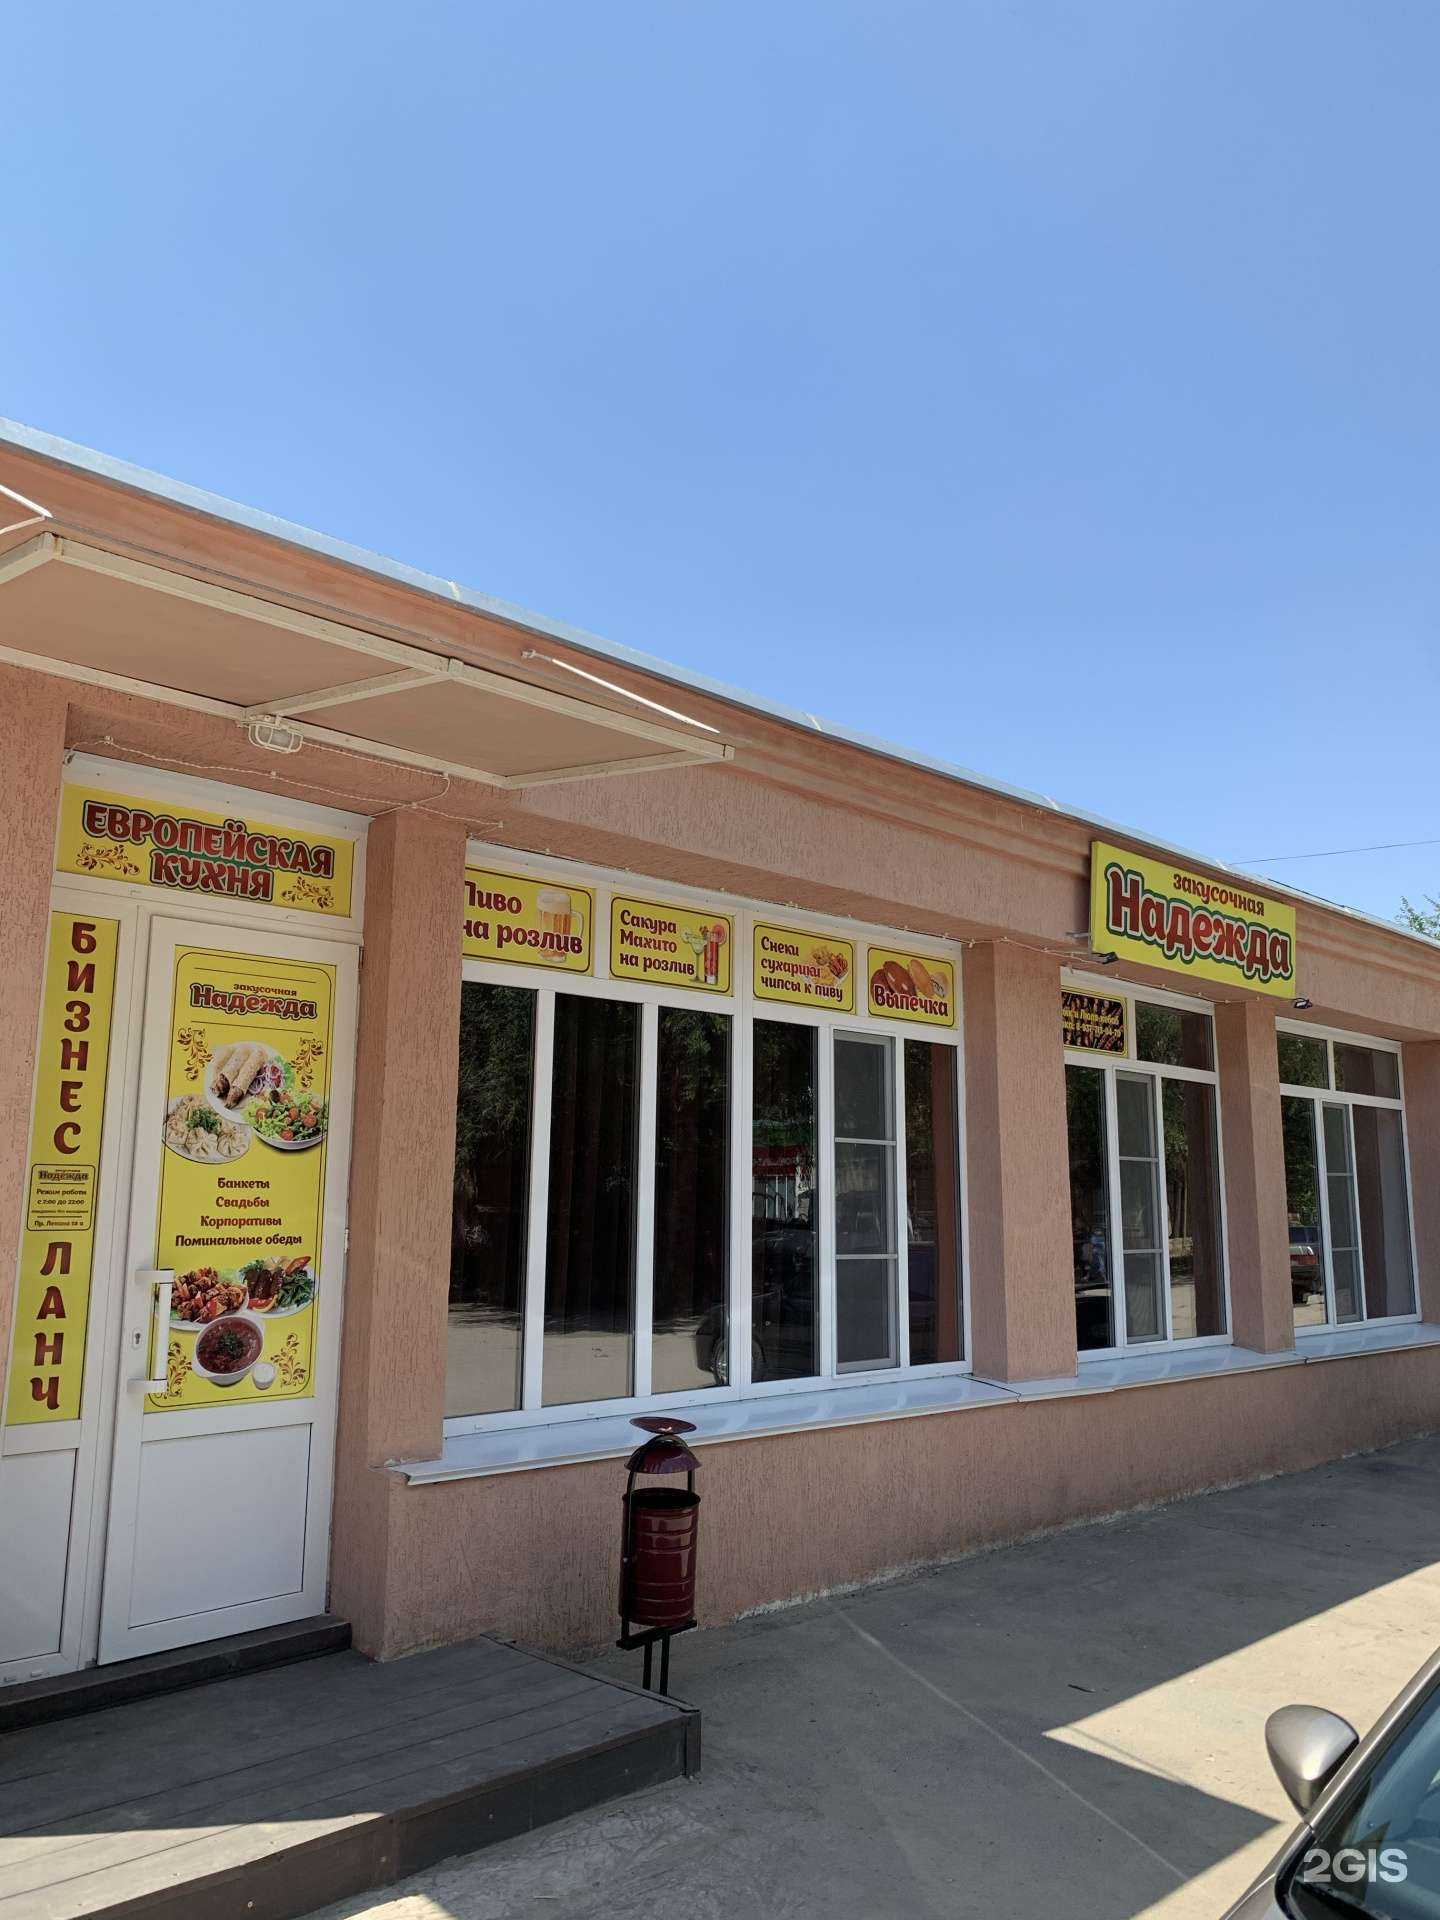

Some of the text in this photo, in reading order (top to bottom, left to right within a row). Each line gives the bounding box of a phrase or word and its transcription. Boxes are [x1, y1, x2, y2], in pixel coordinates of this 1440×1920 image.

[83, 801, 334, 878] ЕВРОПЕЙСКАЯ
[150, 850, 274, 901] КУХНЯ
[464, 880, 522, 914] Пиво
[1173, 873, 1265, 916] закусочная
[620, 909, 677, 935] Сакура
[1104, 863, 1293, 983] Надежда
[496, 923, 583, 954] розлив
[620, 928, 677, 953] Махито
[761, 936, 800, 957] Снеки
[619, 953, 695, 975] на розлив
[761, 957, 821, 979] сухарики
[190, 982, 317, 1021] Надежда
[233, 983, 297, 997] закусочная
[761, 976, 843, 1002] чипсы к пиву
[873, 983, 949, 1017] Выпечка
[53, 922, 97, 1155] БИЗНЕС
[217, 1177, 270, 1189] Банкеты
[215, 1196, 270, 1209] Свадьбы
[200, 1215, 282, 1229] Корпоративы
[175, 1233, 302, 1247] Поминальные обеды
[30, 1241, 72, 1411] ЛАНЧ
